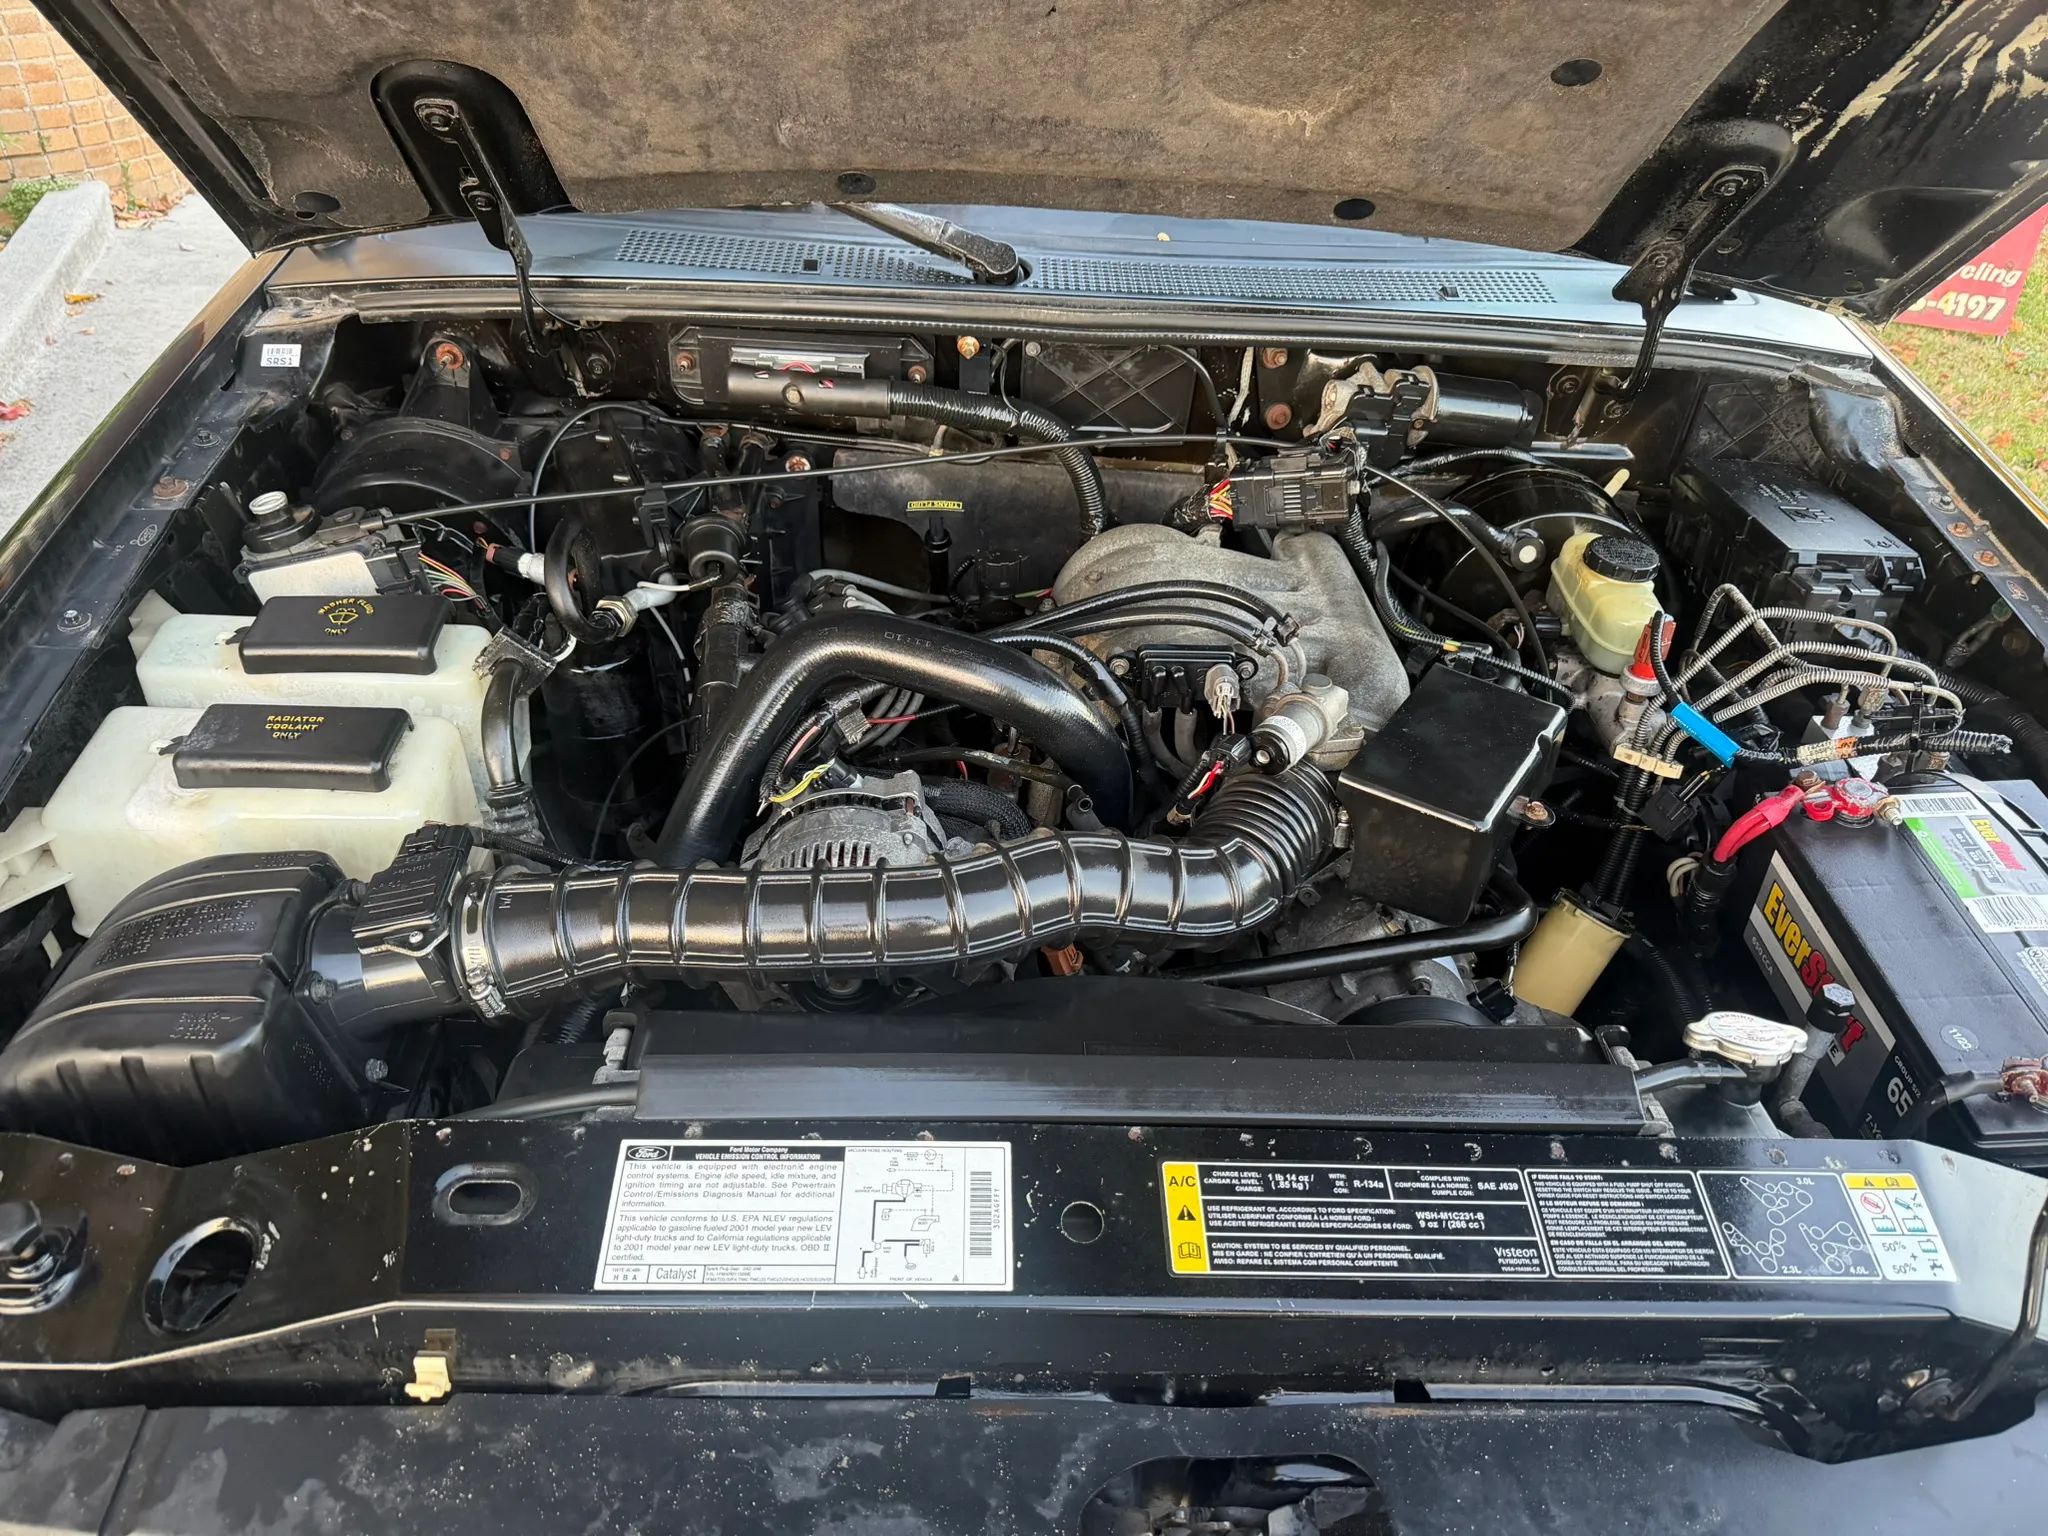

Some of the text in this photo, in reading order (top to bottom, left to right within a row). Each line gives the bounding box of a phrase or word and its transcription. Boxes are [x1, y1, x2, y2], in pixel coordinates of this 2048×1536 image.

[1952, 262, 2022, 287] cling
[266, 357, 292, 366] SRS1
[318, 598, 355, 615] WASHER
[1762, 954, 1774, 976] CCA
[1763, 880, 1866, 1053] EverStt
[1894, 1056, 1922, 1098] GROUP SIZ
[1887, 1077, 1914, 1117] 65
[635, 1148, 660, 1158] Ford
[762, 1146, 788, 1154] Company
[699, 1163, 736, 1171] equipped
[656, 1172, 690, 1180] systems.
[1169, 1176, 1196, 1187] A/C
[1292, 1182, 1304, 1190] kg
[1353, 1180, 1384, 1188] R-134a
[703, 1191, 742, 1199] Diagnosis
[789, 1215, 832, 1223] regulations
[674, 1244, 691, 1252] year
[732, 1244, 769, 1252] light-duty
[1882, 1241, 1906, 1252] 50%
[1494, 1247, 1537, 1257] Visteon
[1782, 1266, 1802, 1274] 2.3L
[1850, 1266, 1869, 1274] 4.0L
[1892, 1265, 1917, 1274] 50%
[656, 1267, 696, 1282] Catalyst
